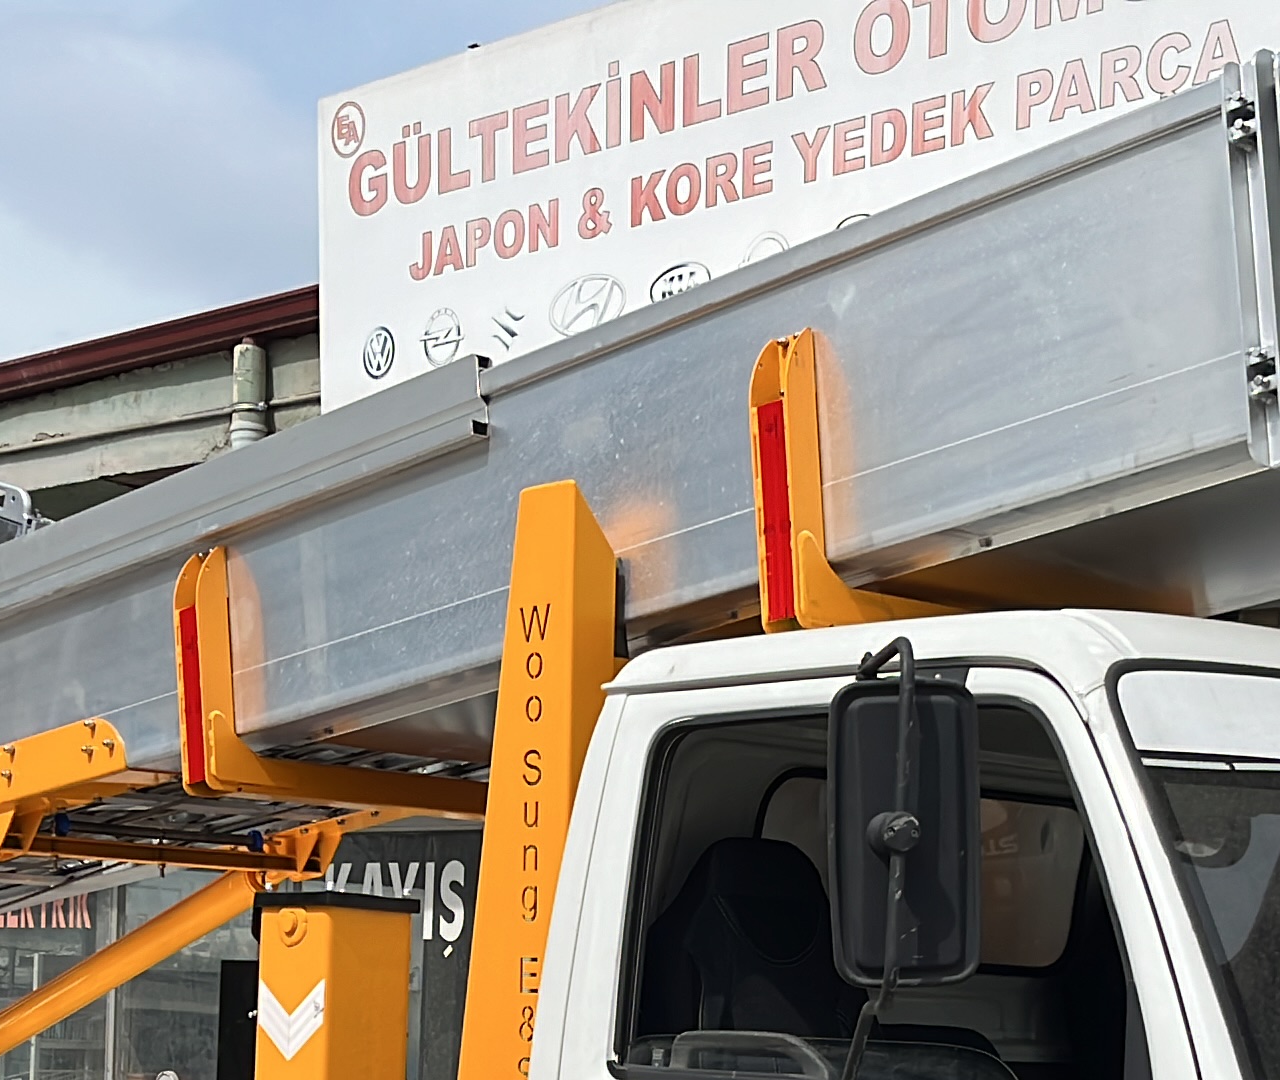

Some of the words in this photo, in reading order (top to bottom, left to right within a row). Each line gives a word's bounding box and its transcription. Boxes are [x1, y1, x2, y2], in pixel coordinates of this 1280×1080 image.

[349, 19, 827, 218] GÜLTEKİNLER
[854, 0, 1145, 75] OTO
[409, 199, 559, 281] JAPON
[577, 187, 612, 240] &
[630, 141, 774, 228] KORE
[792, 82, 994, 184] YEDEK
[1016, 19, 1241, 131] PARÇA
